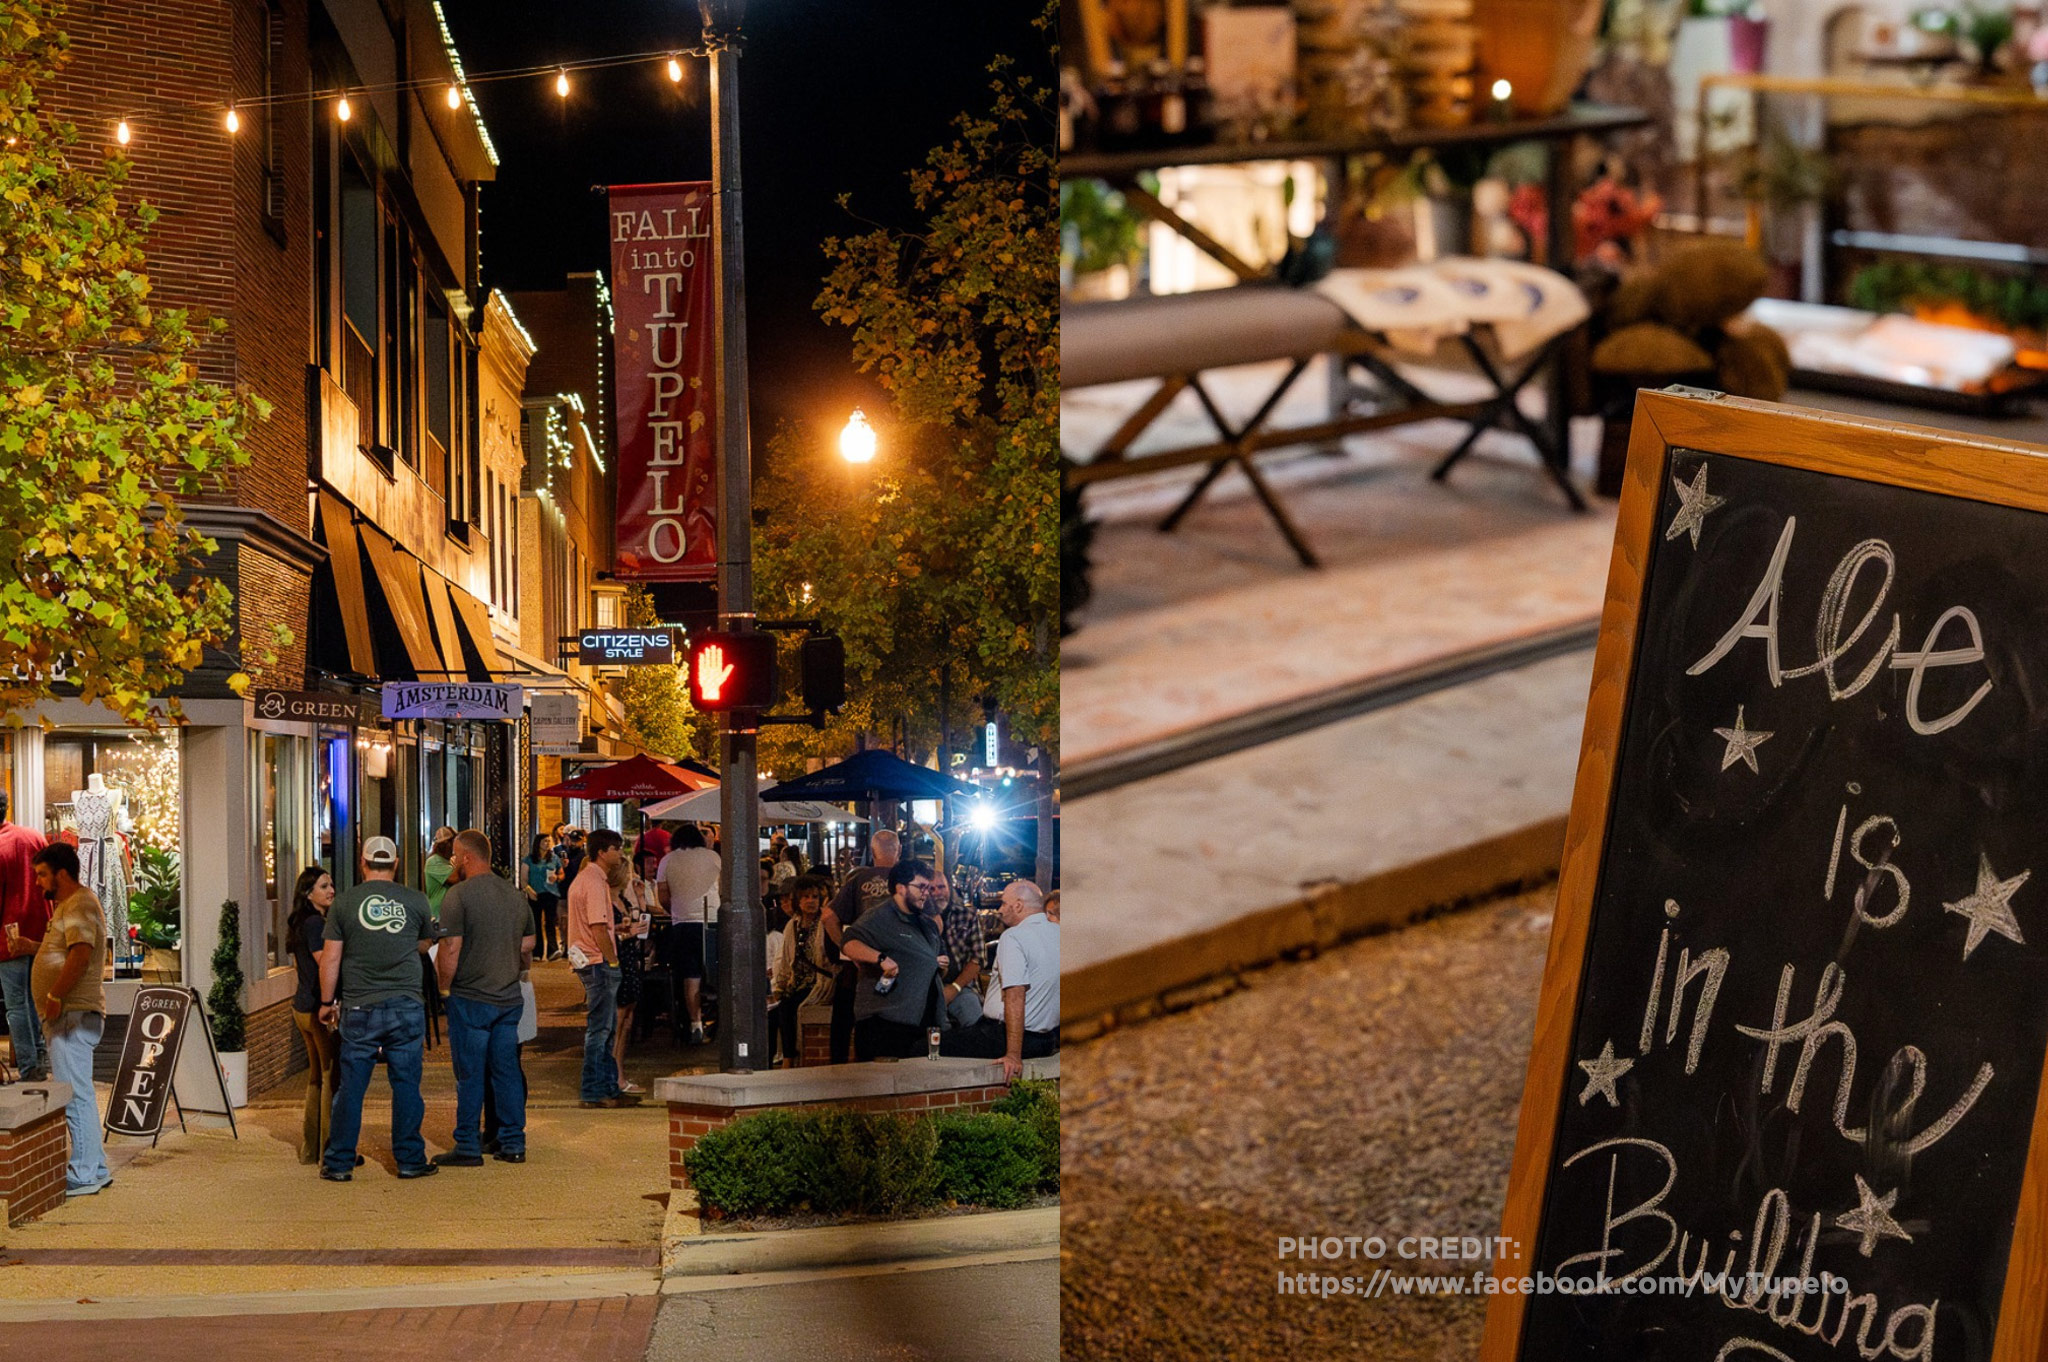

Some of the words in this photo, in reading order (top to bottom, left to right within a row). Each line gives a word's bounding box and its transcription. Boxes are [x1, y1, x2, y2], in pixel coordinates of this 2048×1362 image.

[612, 207, 710, 242] FALL
[631, 247, 694, 269] into
[644, 272, 688, 563] TUPELO
[582, 635, 669, 648] CITIZENS
[605, 648, 643, 658] STYLE
[290, 701, 358, 718] GREEN
[394, 686, 509, 714] AMSTERDAM
[606, 789, 682, 797] Budweiser
[1824, 782, 1910, 929] is
[359, 894, 406, 933] Costa
[151, 999, 182, 1010] GREEN
[1639, 898, 1731, 1076] in
[1734, 961, 1995, 1155] the
[117, 1012, 174, 1128] OPEN
